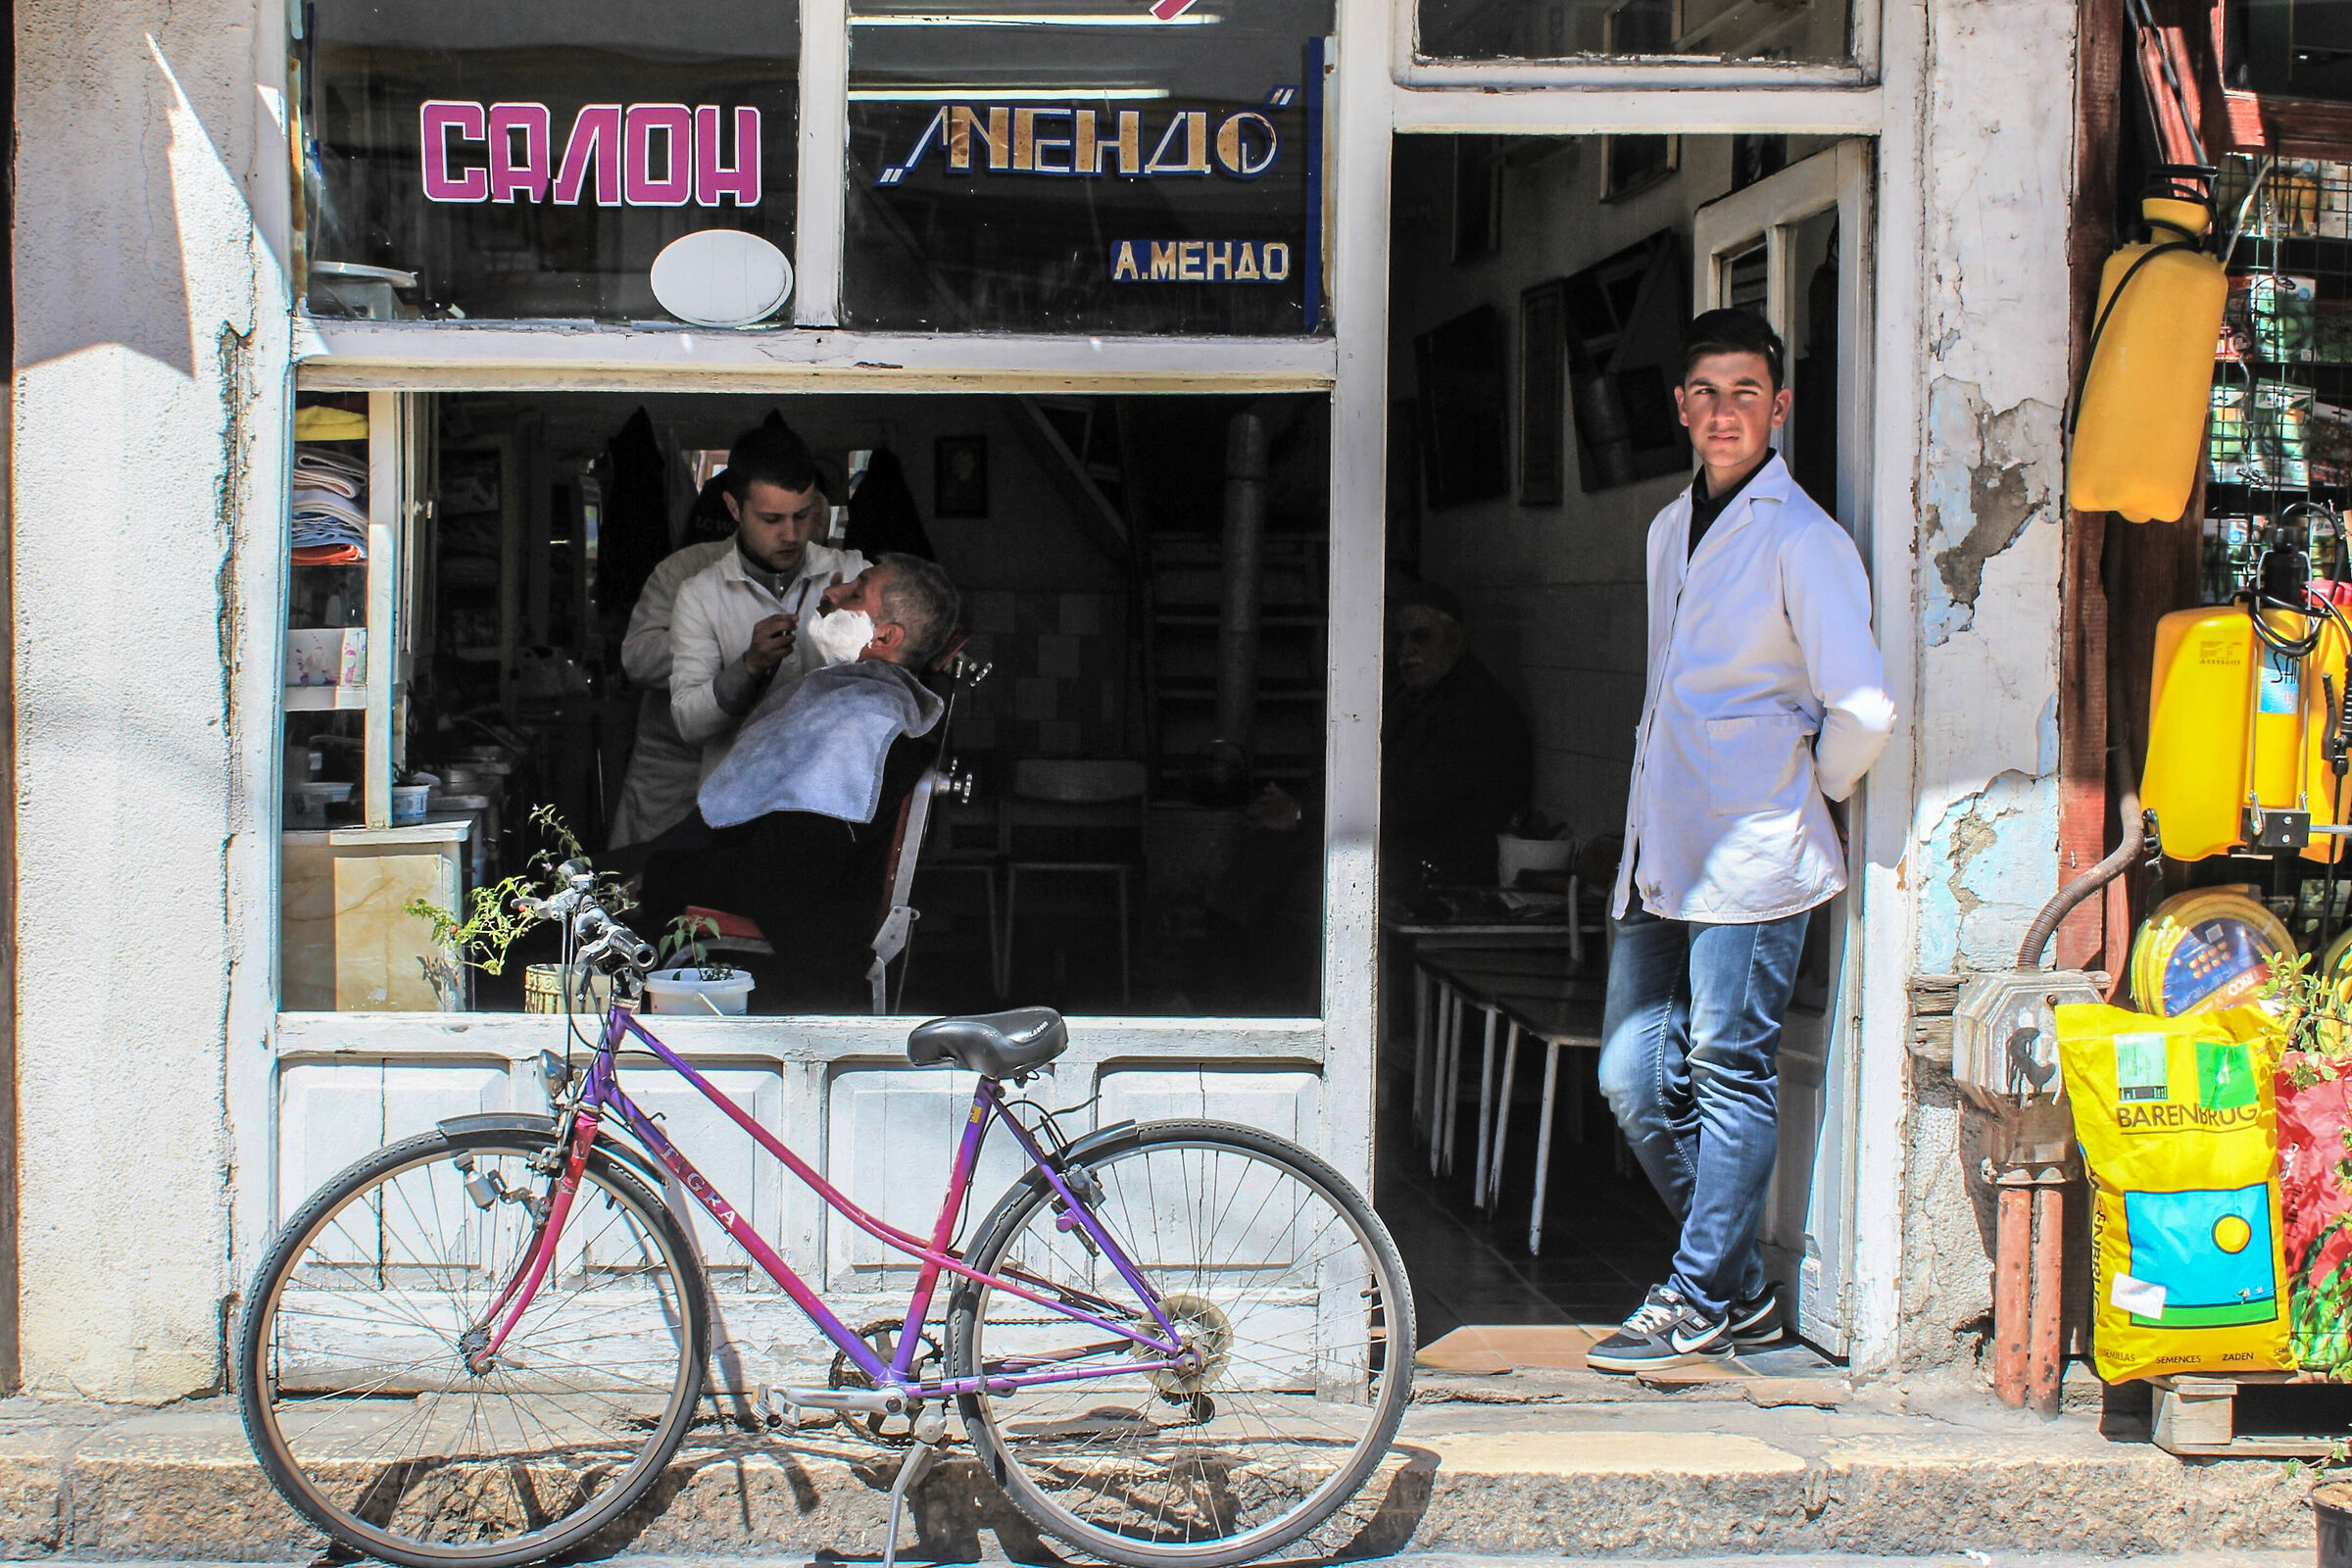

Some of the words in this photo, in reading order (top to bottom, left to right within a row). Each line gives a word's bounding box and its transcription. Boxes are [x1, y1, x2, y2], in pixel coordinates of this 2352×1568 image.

[420, 99, 761, 208] САЛОН
[1112, 240, 1290, 281] А.МЕНДО
[2117, 1103, 2258, 1128] BARENBRUG
[660, 1142, 736, 1228] TGRA
[2103, 1348, 2136, 1362] SEMILLAS
[2156, 1354, 2201, 1364] SEMENCES
[2222, 1352, 2254, 1361] ZADEN
